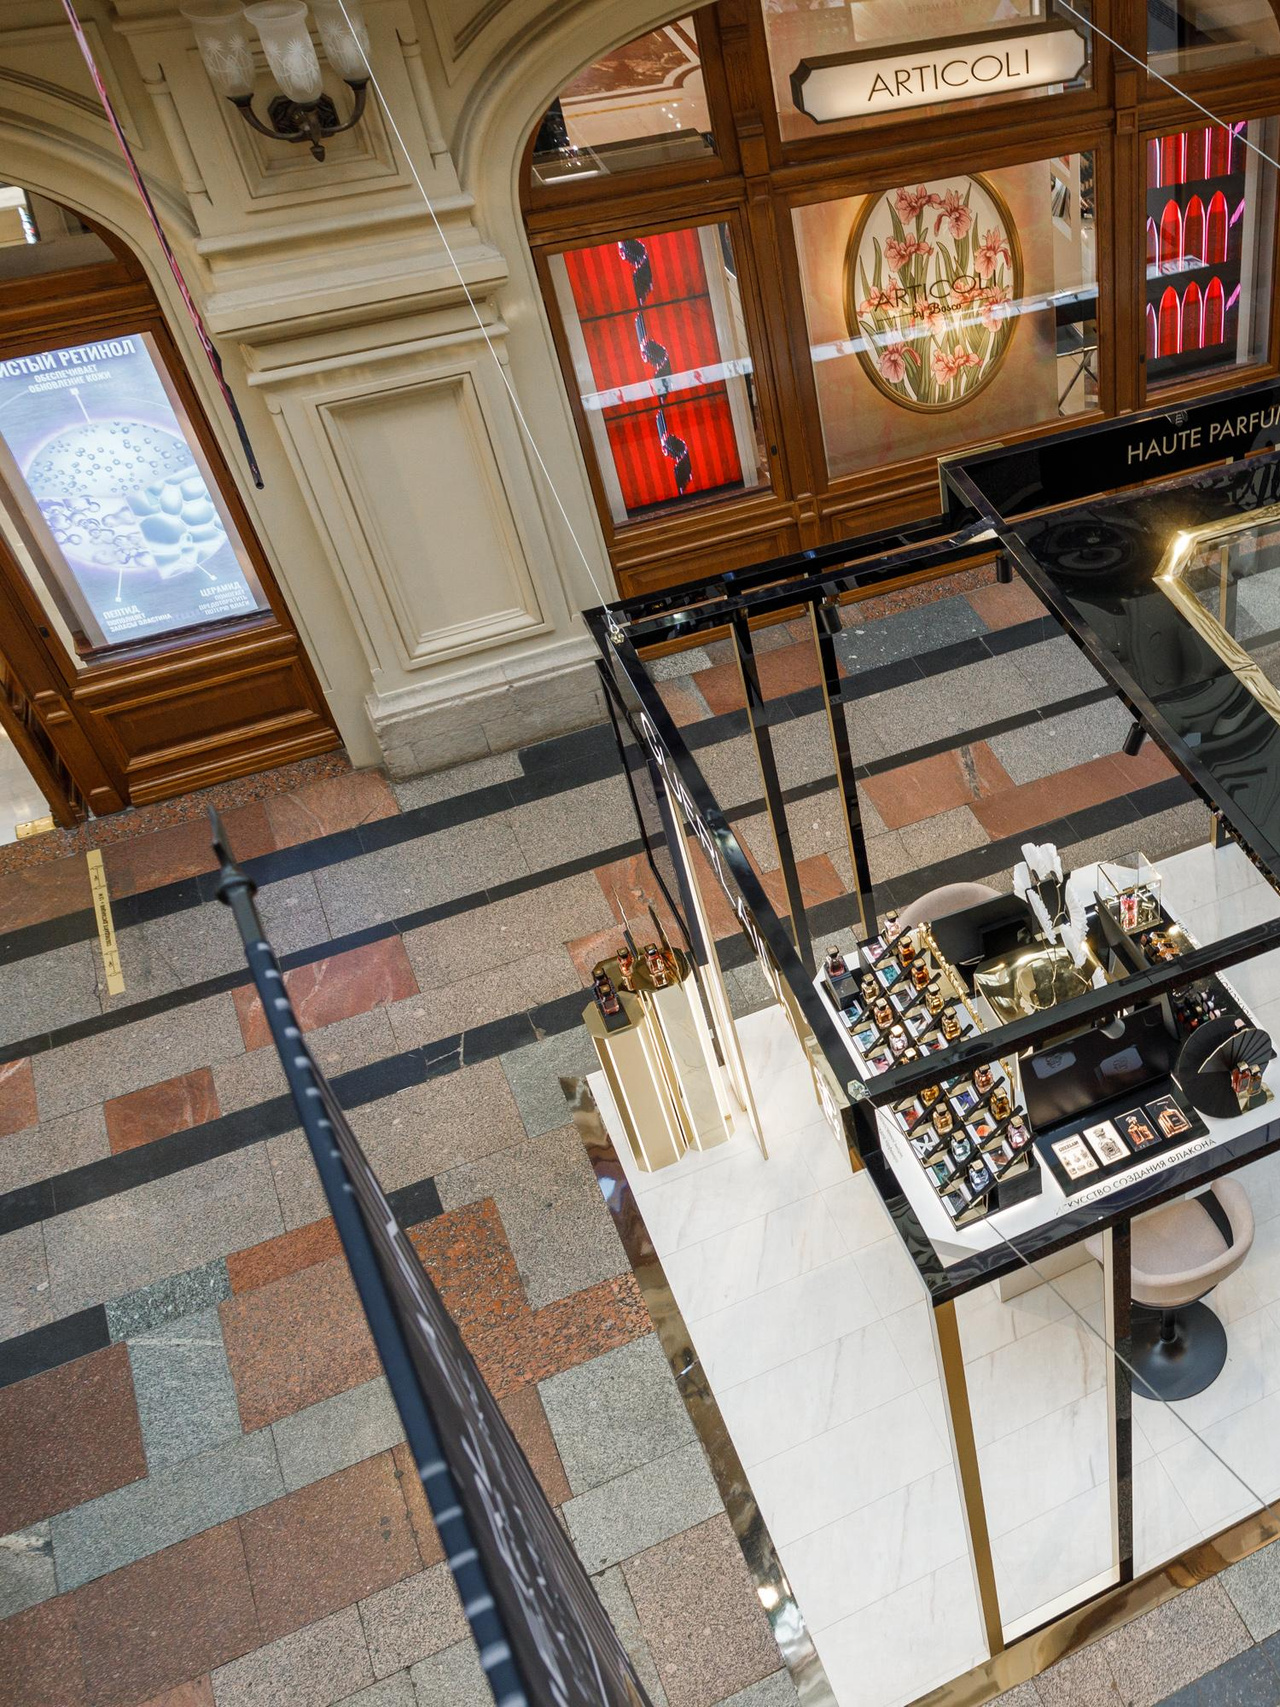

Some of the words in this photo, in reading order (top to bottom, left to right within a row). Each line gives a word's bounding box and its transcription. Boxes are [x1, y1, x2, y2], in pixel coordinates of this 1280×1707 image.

[868, 49, 1030, 101] ARTICOLI
[875, 270, 997, 312] ARTICOLI
[912, 306, 925, 320] by
[927, 302, 962, 315] Bosco
[58, 339, 136, 367] РЕТИНОЛ
[28, 376, 84, 393] ОБНОВЛЕНИЕ
[87, 371, 112, 382] КОЖИ
[34, 364, 98, 383] ОБЕСПЕЧИВАЕТ
[1127, 427, 1202, 465] HAUTE
[200, 582, 242, 597] ЦЕРАМИД
[103, 605, 140, 619] ПЕПТИД
[1054, 1185, 1112, 1215] ИСКУССТВО
[1113, 1161, 1167, 1189] СОЗДАНИЯ
[1167, 1138, 1217, 1163] ФЛАКОНА
